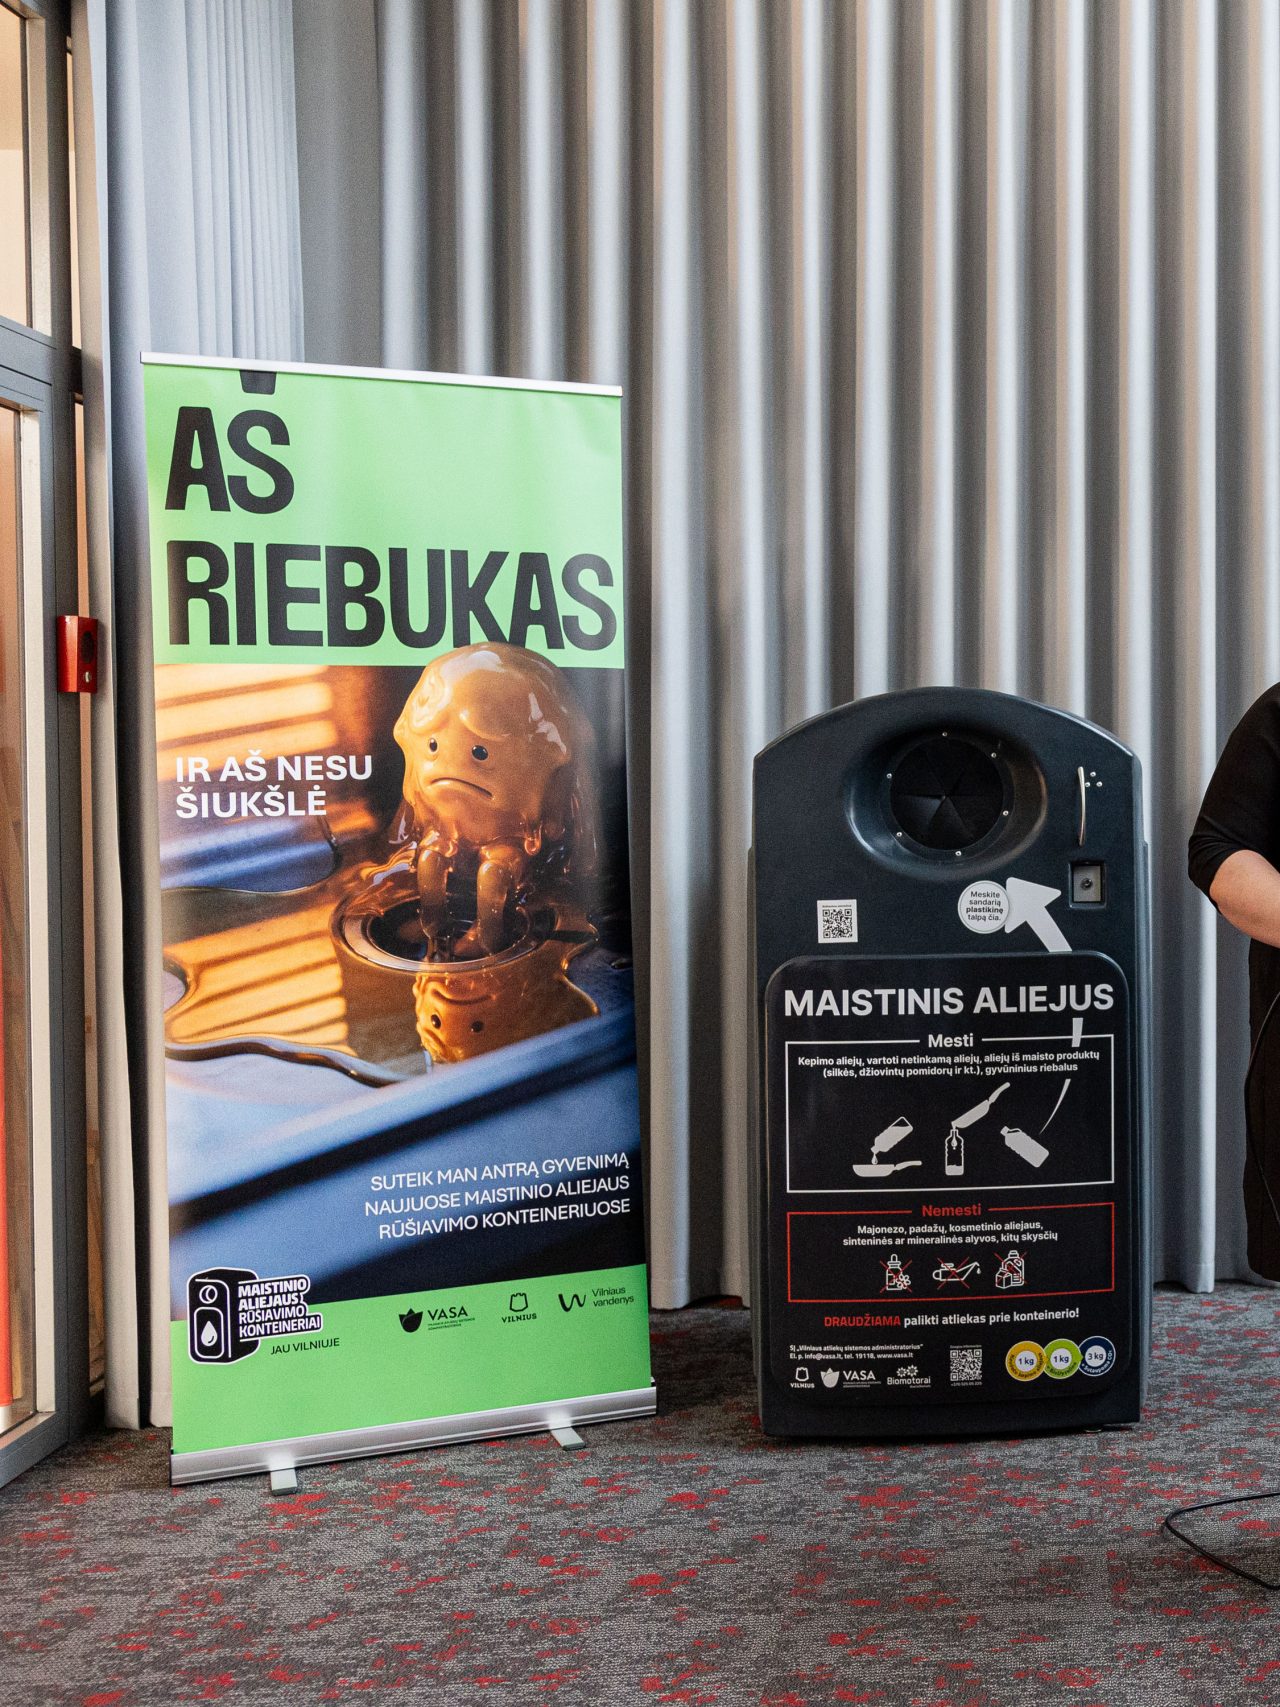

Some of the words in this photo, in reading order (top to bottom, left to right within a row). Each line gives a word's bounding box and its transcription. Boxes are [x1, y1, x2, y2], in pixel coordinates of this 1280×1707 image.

[165, 370, 294, 514] AŠ
[166, 540, 617, 651] RIEBUKAS
[176, 757, 210, 782] IR
[219, 750, 267, 782] AŠ
[277, 755, 373, 781] NESU
[175, 784, 327, 819] ŠIUKŠLĖ
[969, 899, 1001, 907] sandarią
[968, 914, 986, 922] talpą
[784, 987, 964, 1017] MAISTINIS
[973, 983, 1114, 1013] ALIEJUS
[928, 1034, 974, 1048] Mesti
[798, 1057, 835, 1068] Kepimo
[836, 1056, 865, 1067] aliejų,
[866, 1055, 899, 1065] vartoti
[901, 1054, 952, 1066] netinkamą
[953, 1053, 983, 1065] aliejų,
[984, 1053, 1010, 1064] aliejų
[1011, 1051, 1021, 1061] iš
[1022, 1051, 1054, 1061] maisto
[1056, 1050, 1100, 1062] produktų
[823, 1067, 858, 1078] (silkės,
[859, 1065, 905, 1077] džiovintų
[906, 1065, 952, 1077] pomidorų
[954, 1064, 962, 1074] ir
[963, 1064, 983, 1075] kt.),
[985, 1063, 1038, 1075] gyvūninius
[1039, 1061, 1078, 1072] riebalus
[370, 1171, 433, 1191] SUTEIK
[438, 1167, 477, 1185] MAN
[481, 1161, 539, 1182] ANTRĄ
[542, 1152, 630, 1174] GYVENIMĄ
[365, 1193, 460, 1216] NAUJUOSE
[465, 1184, 552, 1206] MAISTINIO
[555, 1176, 630, 1197] ALIEJAUS
[922, 1204, 982, 1217] Nemesti
[379, 1215, 479, 1240] RŪŠIAVIMO
[482, 1199, 631, 1229] KONTEINERIUOSE
[857, 1224, 907, 1236] Majonezo,
[909, 1222, 947, 1235] padažų,
[949, 1222, 1002, 1232] kosmetinio
[1004, 1220, 1044, 1231] aliejaus,
[843, 1235, 894, 1246] sinteninės
[895, 1237, 905, 1245] ar
[907, 1234, 963, 1245] mineralinės
[965, 1233, 999, 1244] alyvos,
[1000, 1231, 1019, 1243] kitų
[1021, 1230, 1058, 1243] skysčių
[238, 1279, 307, 1298] MAISTINIO
[592, 1287, 626, 1297] Vilniaus
[238, 1293, 299, 1311] ALIEJAUS
[593, 1296, 635, 1308] vandenys
[239, 1305, 305, 1325] RŪŠIAVIMO
[427, 1305, 469, 1320] VASA
[501, 1313, 537, 1324] VILNIUS
[824, 1314, 901, 1328] DRAUDŽIAMA
[903, 1315, 939, 1329] palikti
[941, 1313, 986, 1325] atliekas
[989, 1312, 1011, 1325] prie
[1013, 1308, 1080, 1323] konteinerio!
[239, 1316, 321, 1338] KONTEINERIAI
[270, 1344, 290, 1355] JAU
[293, 1338, 340, 1352] VILNIUJE
[1024, 1357, 1034, 1366] kg
[1059, 1355, 1069, 1364] kg
[1094, 1352, 1104, 1361] kg
[843, 1370, 876, 1381] VASA
[887, 1376, 931, 1385] Biomotorai
